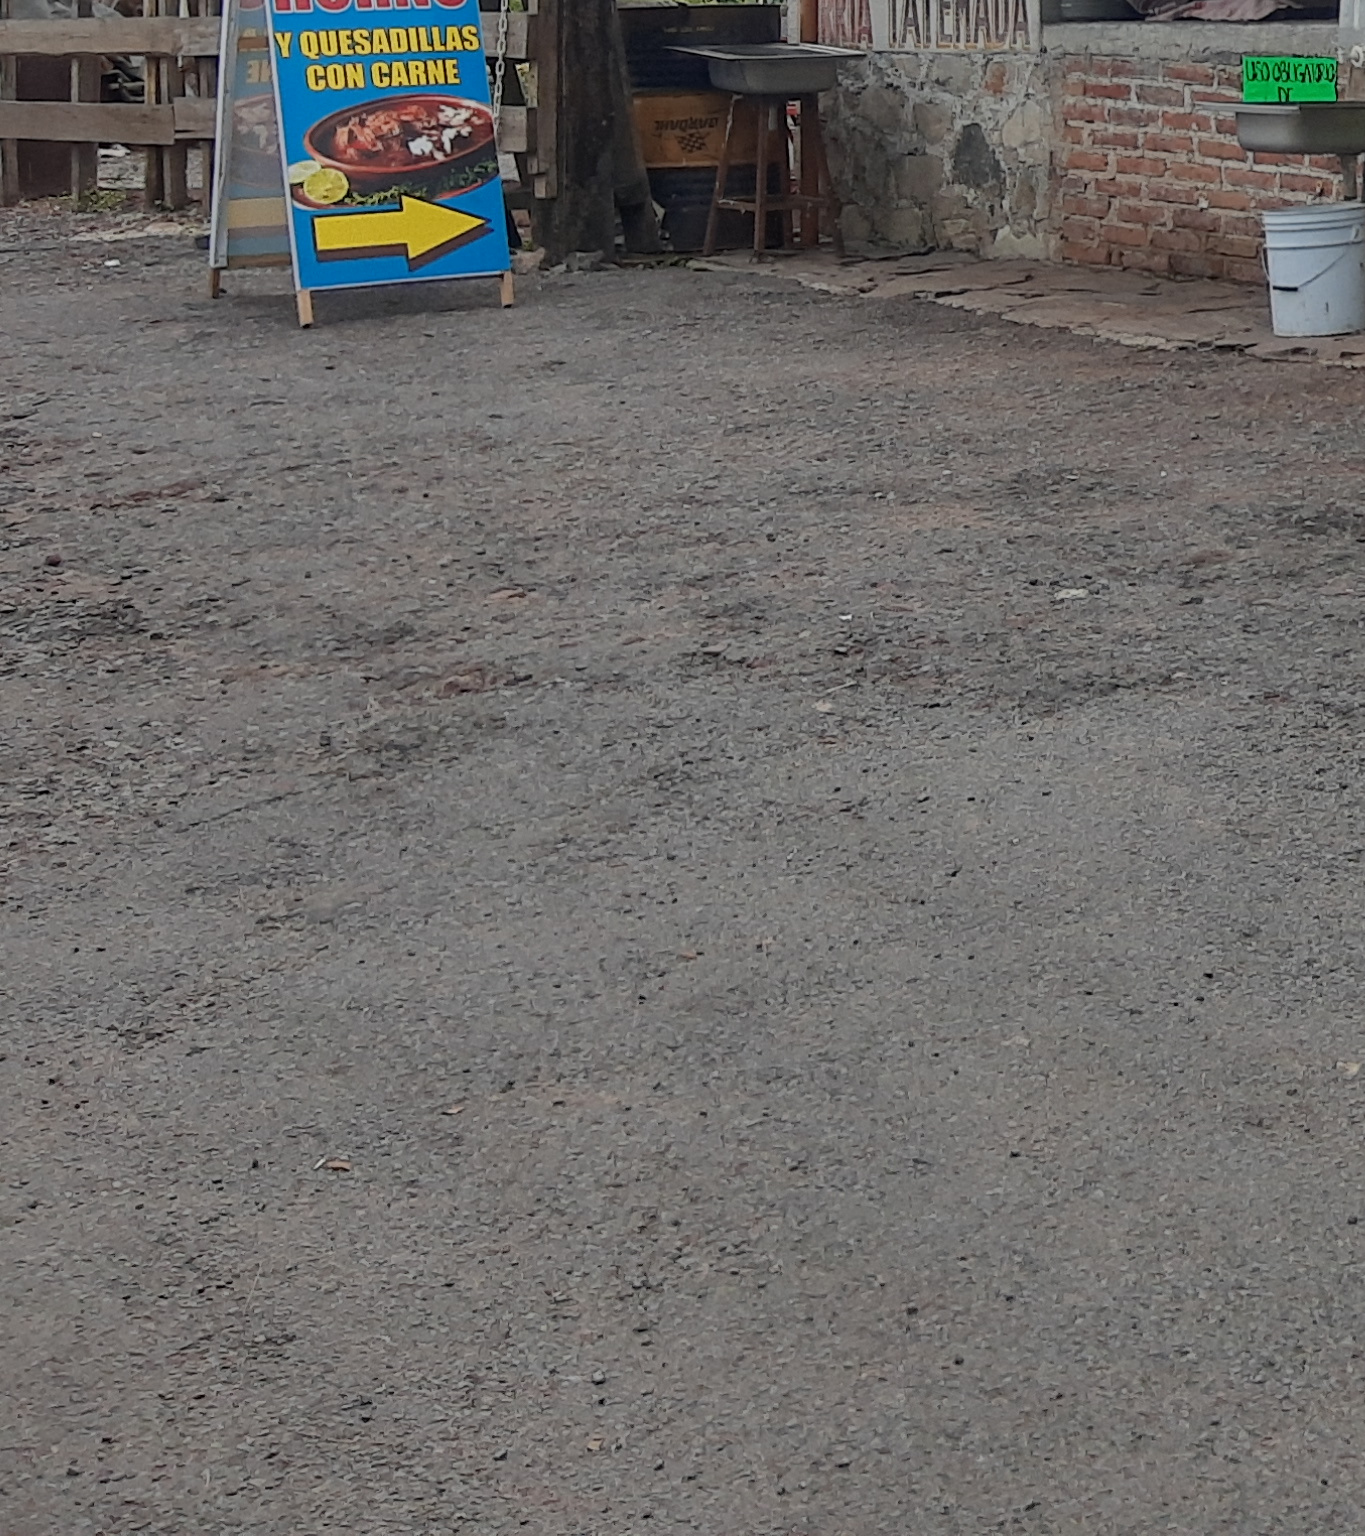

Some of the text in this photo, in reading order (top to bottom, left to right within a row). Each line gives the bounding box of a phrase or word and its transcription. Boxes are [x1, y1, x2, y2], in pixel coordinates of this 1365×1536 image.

[275, 32, 292, 58] Y
[298, 25, 481, 59] QUESADILLAS
[305, 63, 365, 91] CON
[370, 59, 461, 87] CARNE
